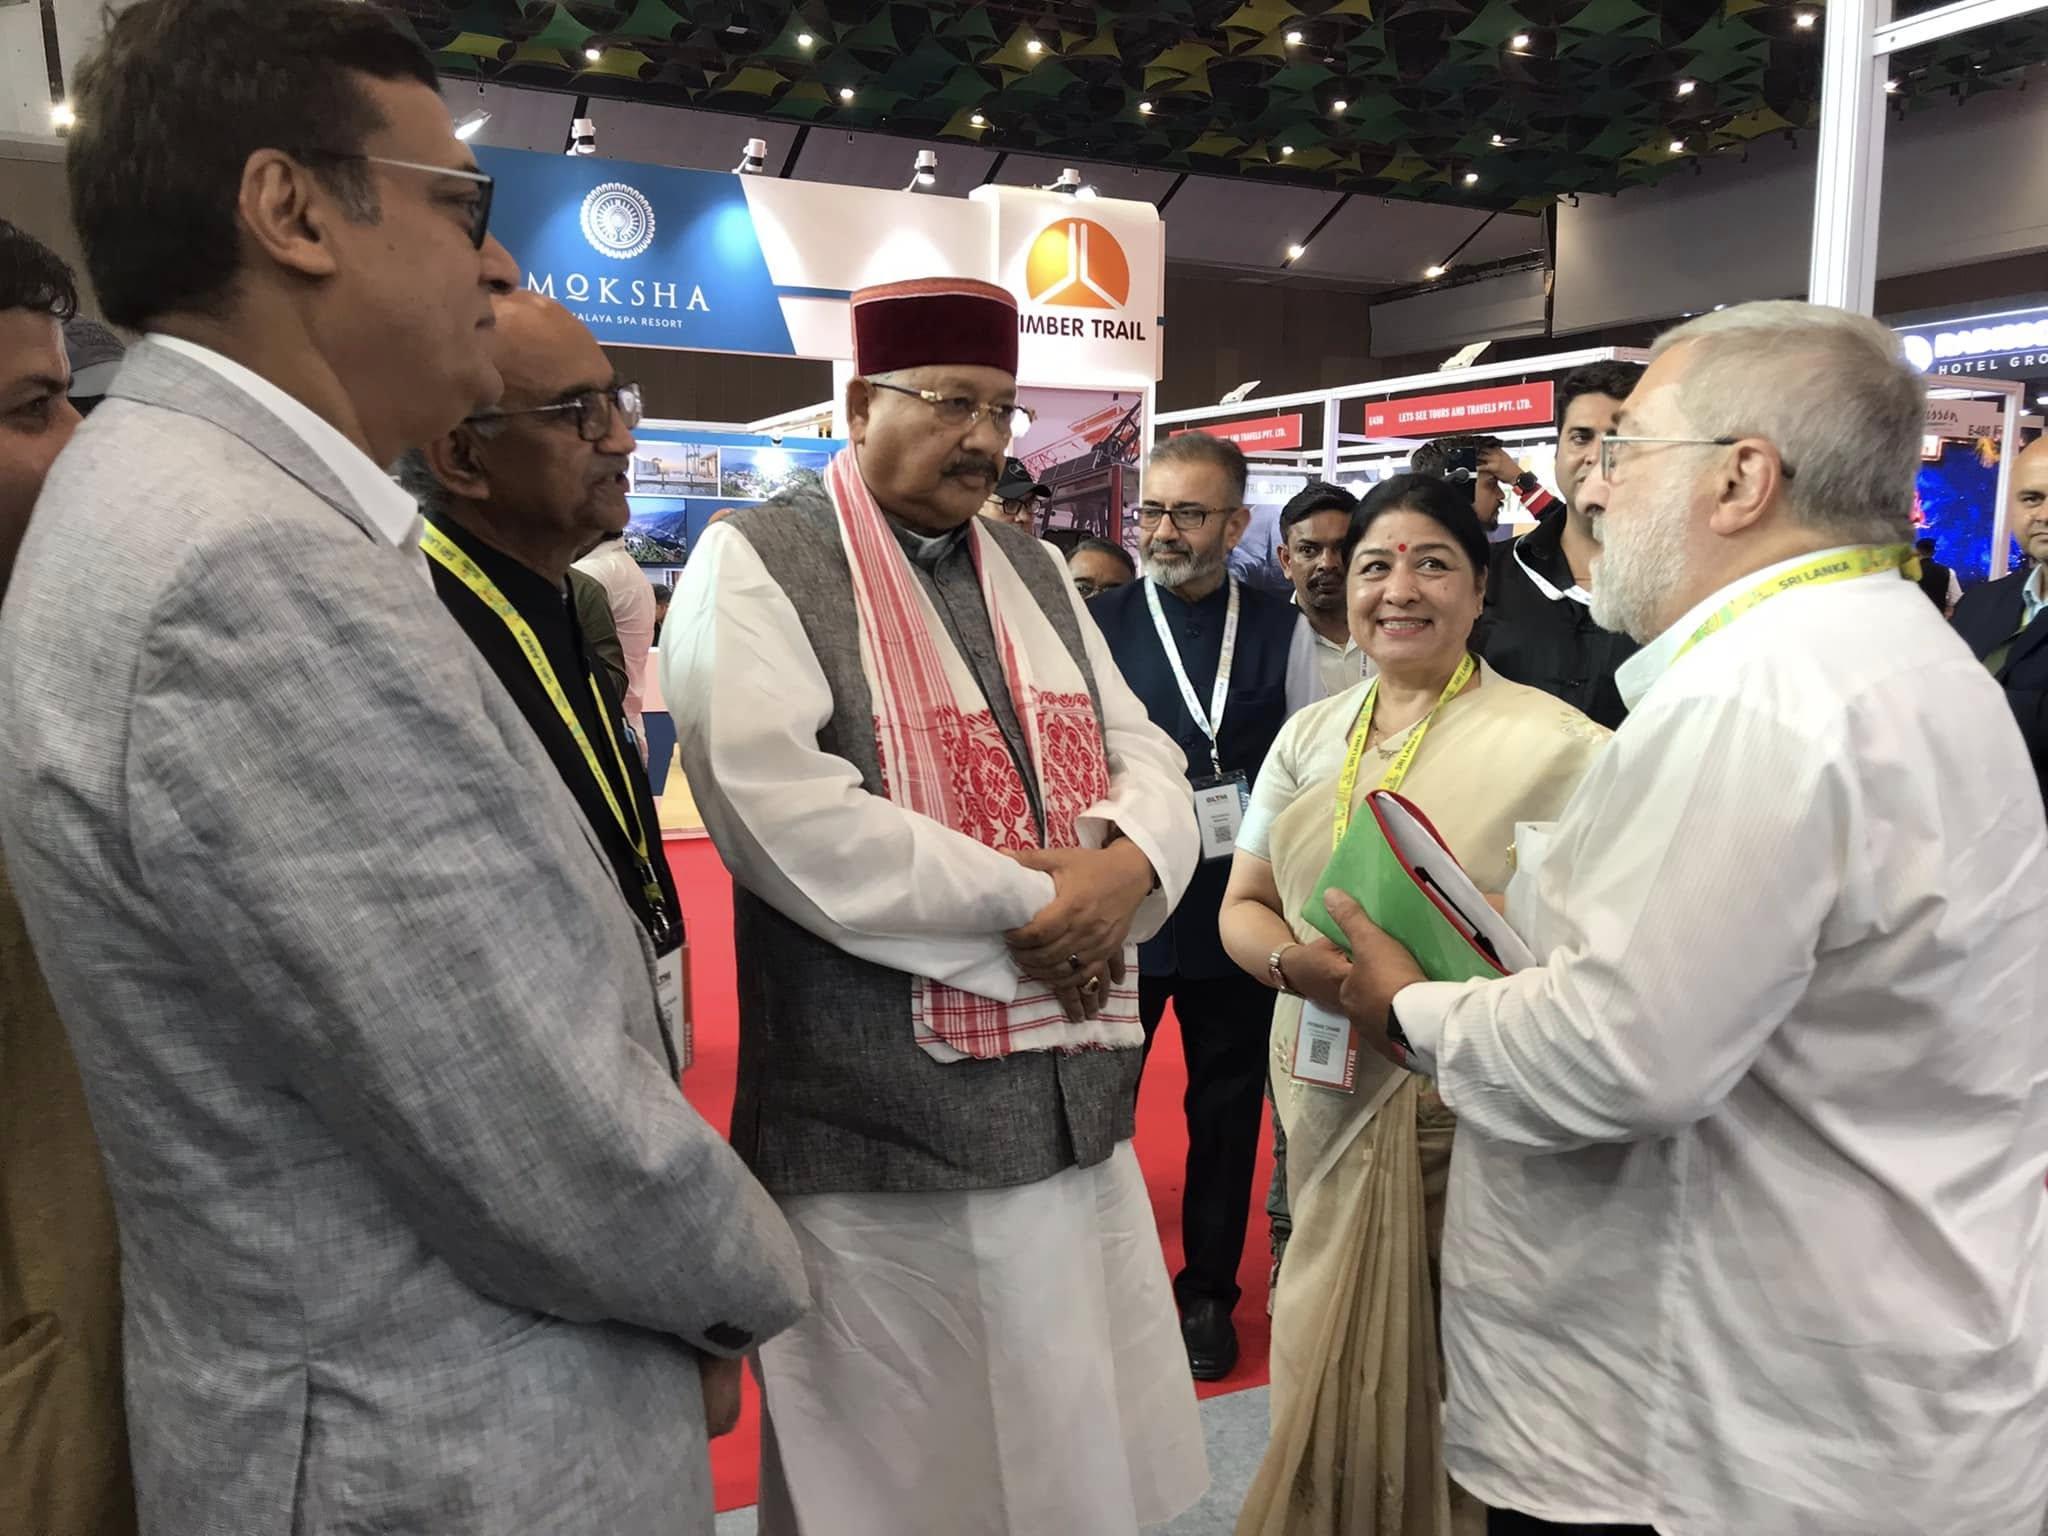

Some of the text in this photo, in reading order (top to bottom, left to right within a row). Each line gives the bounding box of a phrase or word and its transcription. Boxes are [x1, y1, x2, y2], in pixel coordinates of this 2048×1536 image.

[572, 312, 683, 329] ALAYA SPA RESORT
[1018, 313, 1146, 341] IMBER TRAIL
[1938, 353, 2048, 375] HOTEL GRO
[1398, 411, 1414, 423] LETS
[1415, 410, 1427, 421] SEE
[1429, 408, 1449, 419] TOURS
[1451, 406, 1465, 417] AND
[1467, 403, 1496, 416] TRAVELS
[1778, 560, 1851, 591] SRI LANKA
[1344, 1048, 1358, 1088] INVITEE
